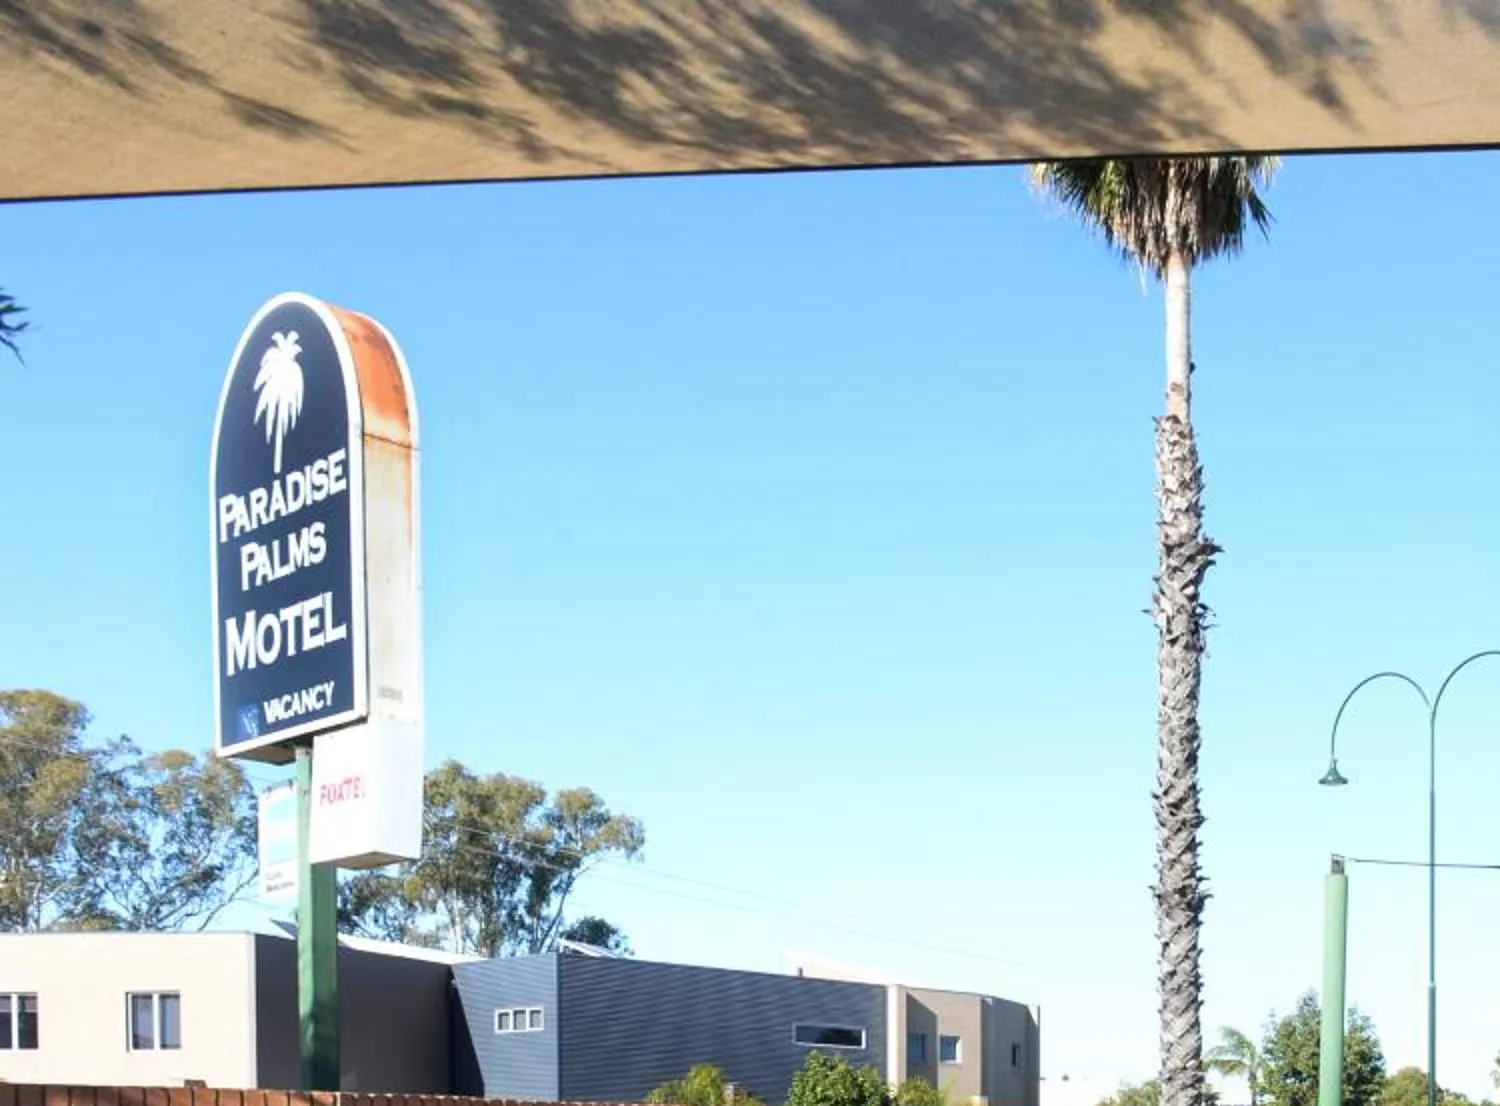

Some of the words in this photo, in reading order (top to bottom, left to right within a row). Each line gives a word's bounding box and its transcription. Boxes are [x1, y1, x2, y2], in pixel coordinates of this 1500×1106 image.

[219, 448, 347, 543] PARADISE
[240, 521, 326, 591] PALMS
[225, 591, 347, 677] MOTEL
[262, 681, 335, 724] VACANCY
